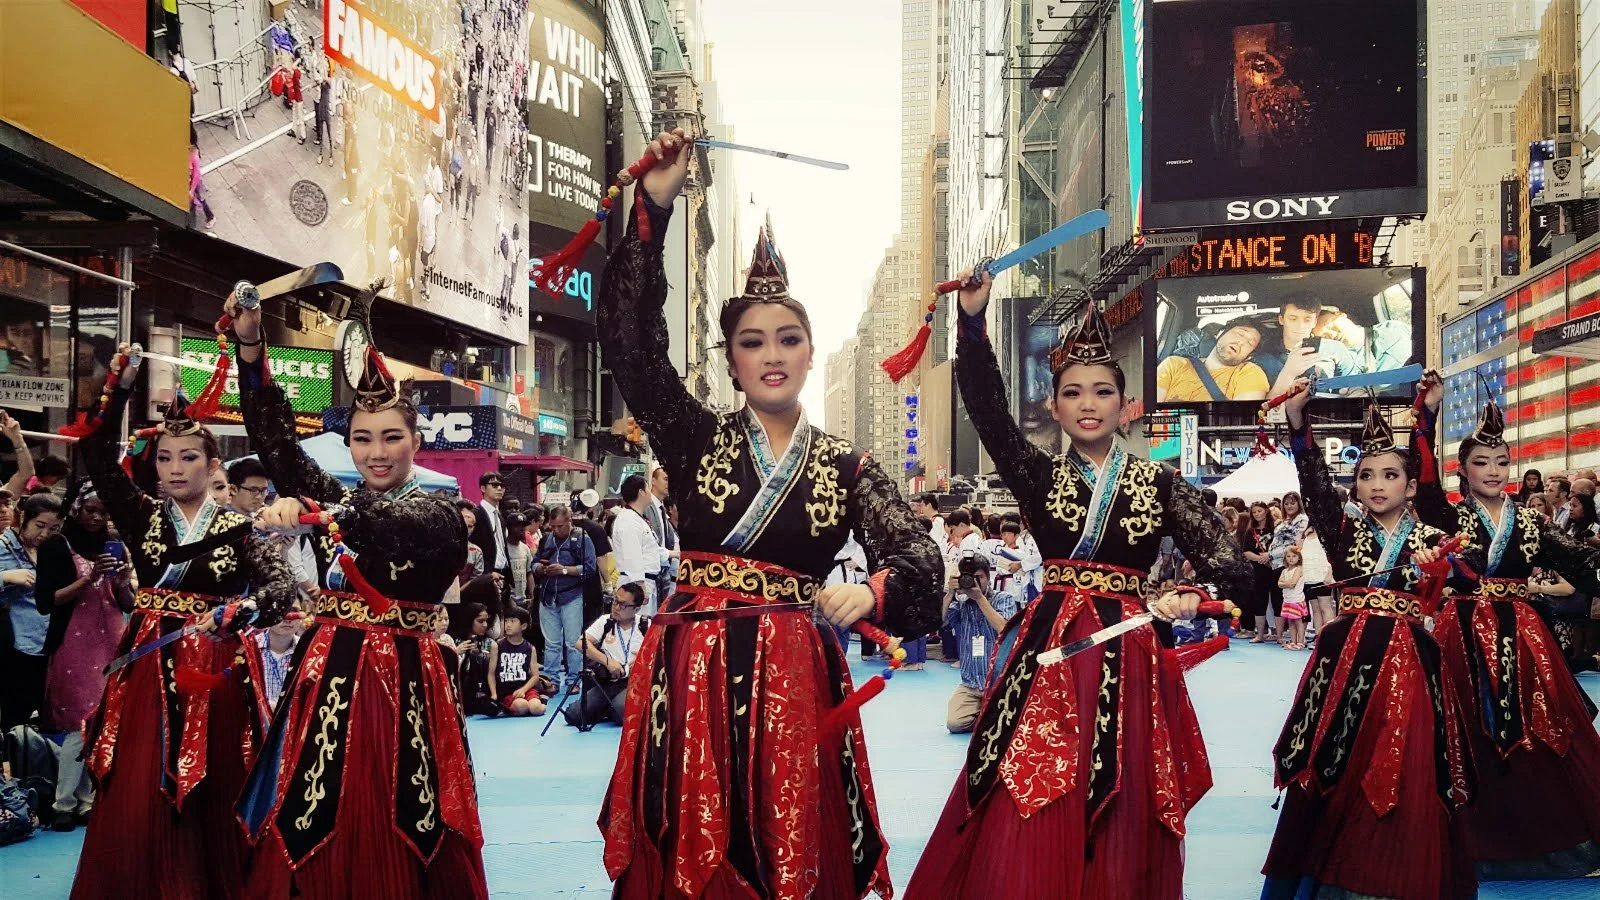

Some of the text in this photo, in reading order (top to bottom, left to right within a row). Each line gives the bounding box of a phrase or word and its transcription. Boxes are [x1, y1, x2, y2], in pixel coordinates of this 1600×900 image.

[328, 0, 436, 110] FAMOUS
[1366, 132, 1406, 147] POWERS
[547, 141, 592, 173] THERAPY
[548, 162, 602, 199] FOR HOW WE
[548, 180, 599, 213] LIVE TODAY
[1226, 195, 1340, 221] SONY
[1145, 234, 1197, 247] SHERWOOD
[1190, 236, 1286, 273] STANCE
[1302, 233, 1336, 264] ON
[423, 266, 523, 318] #InternetFamousMovie
[1197, 293, 1238, 304] Autotrader
[1561, 320, 1591, 339] STRAND
[14, 391, 33, 401] KEEP
[36, 393, 65, 403] MOVING
[23, 380, 44, 390] FLOW
[45, 382, 65, 392] ZONE
[1184, 417, 1195, 476] NYPD
